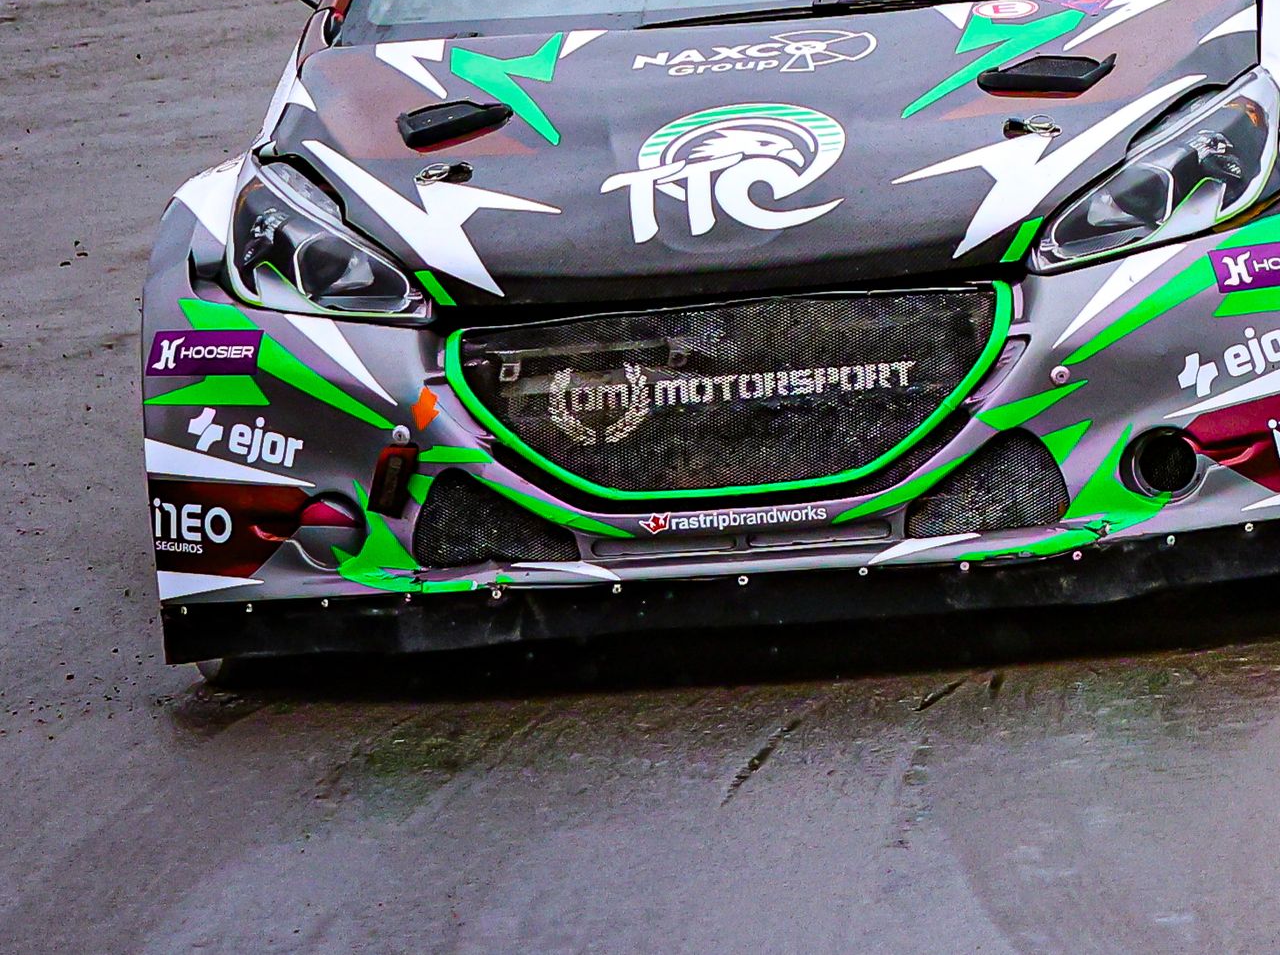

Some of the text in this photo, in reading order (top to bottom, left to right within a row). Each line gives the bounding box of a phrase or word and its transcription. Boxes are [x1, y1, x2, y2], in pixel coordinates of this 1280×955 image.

[668, 57, 778, 77] Group
[180, 345, 255, 360] HOOSIER
[654, 361, 917, 406] MOTORSPORT
[228, 417, 304, 468] ejor
[155, 540, 203, 554] SEGUROS
